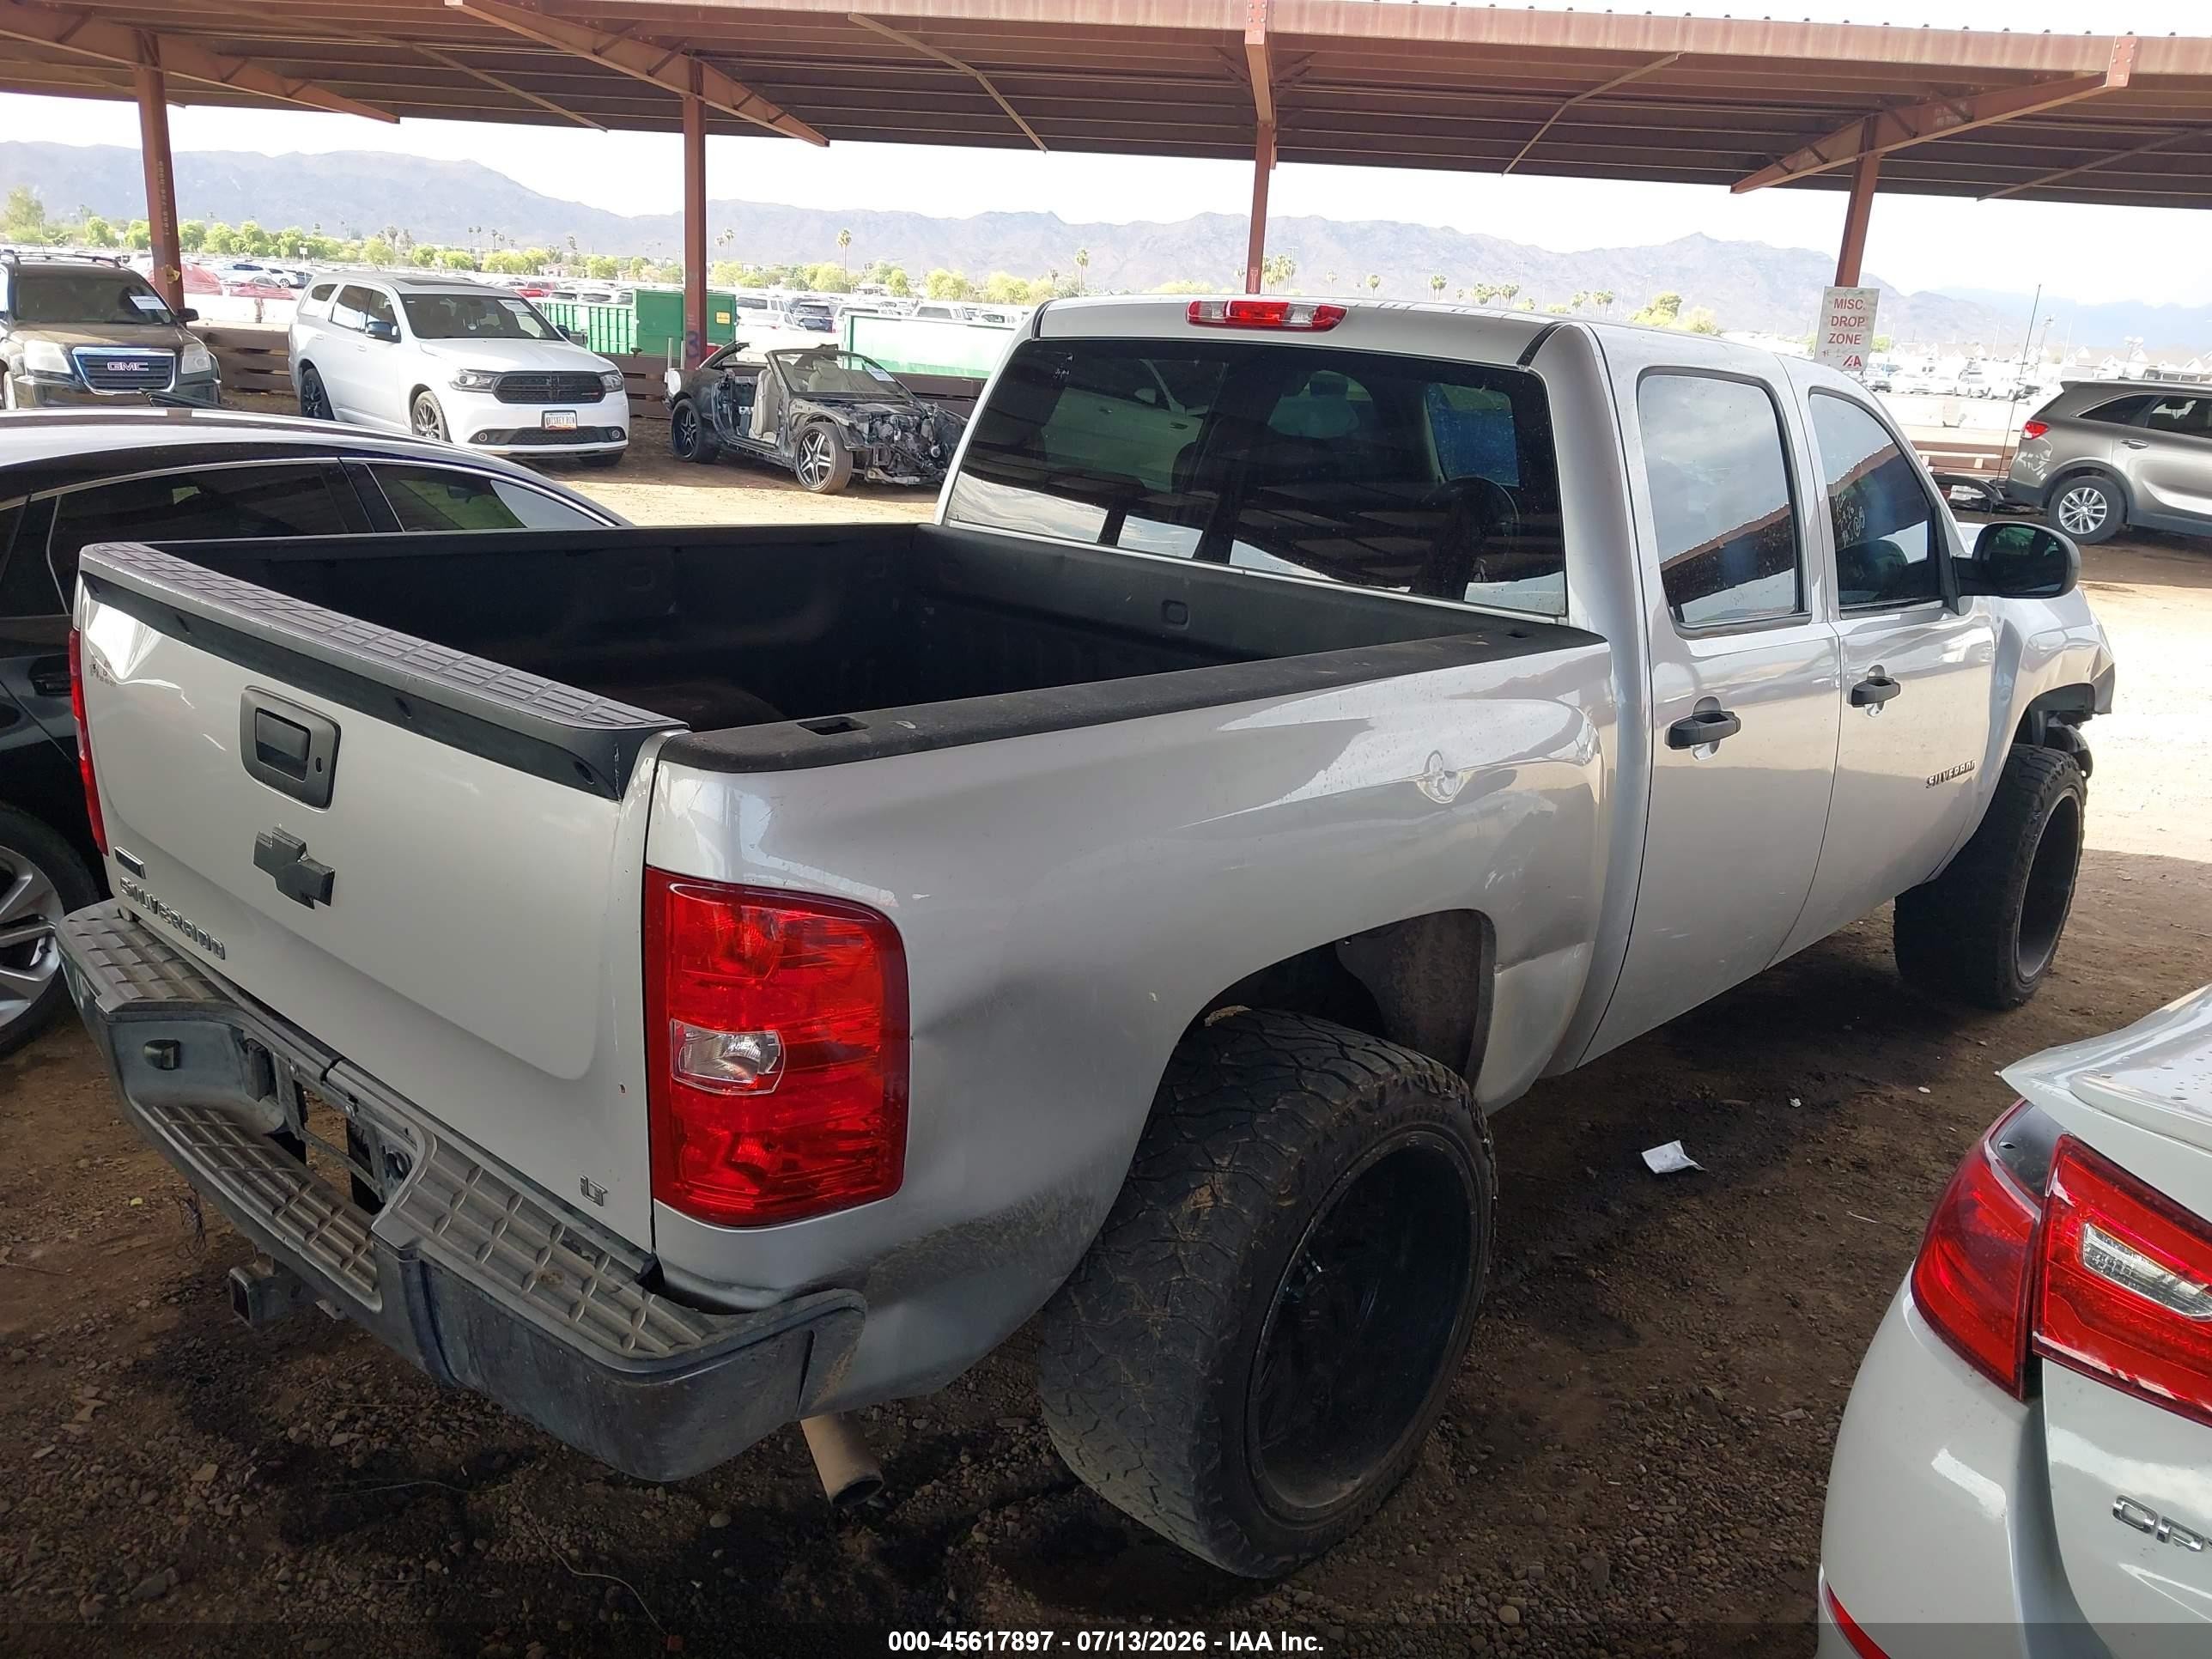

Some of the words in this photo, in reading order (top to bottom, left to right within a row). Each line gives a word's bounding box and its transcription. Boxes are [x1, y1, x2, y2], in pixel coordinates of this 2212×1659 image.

[1834, 298, 1866, 310] MISC.
[1831, 315, 1865, 327] DROP
[1827, 332, 1862, 345] ZONE
[107, 362, 149, 372] GMC
[1925, 759, 1976, 789] SILVERADO
[119, 877, 225, 960] SILVERADO
[580, 1175, 608, 1206] LT
